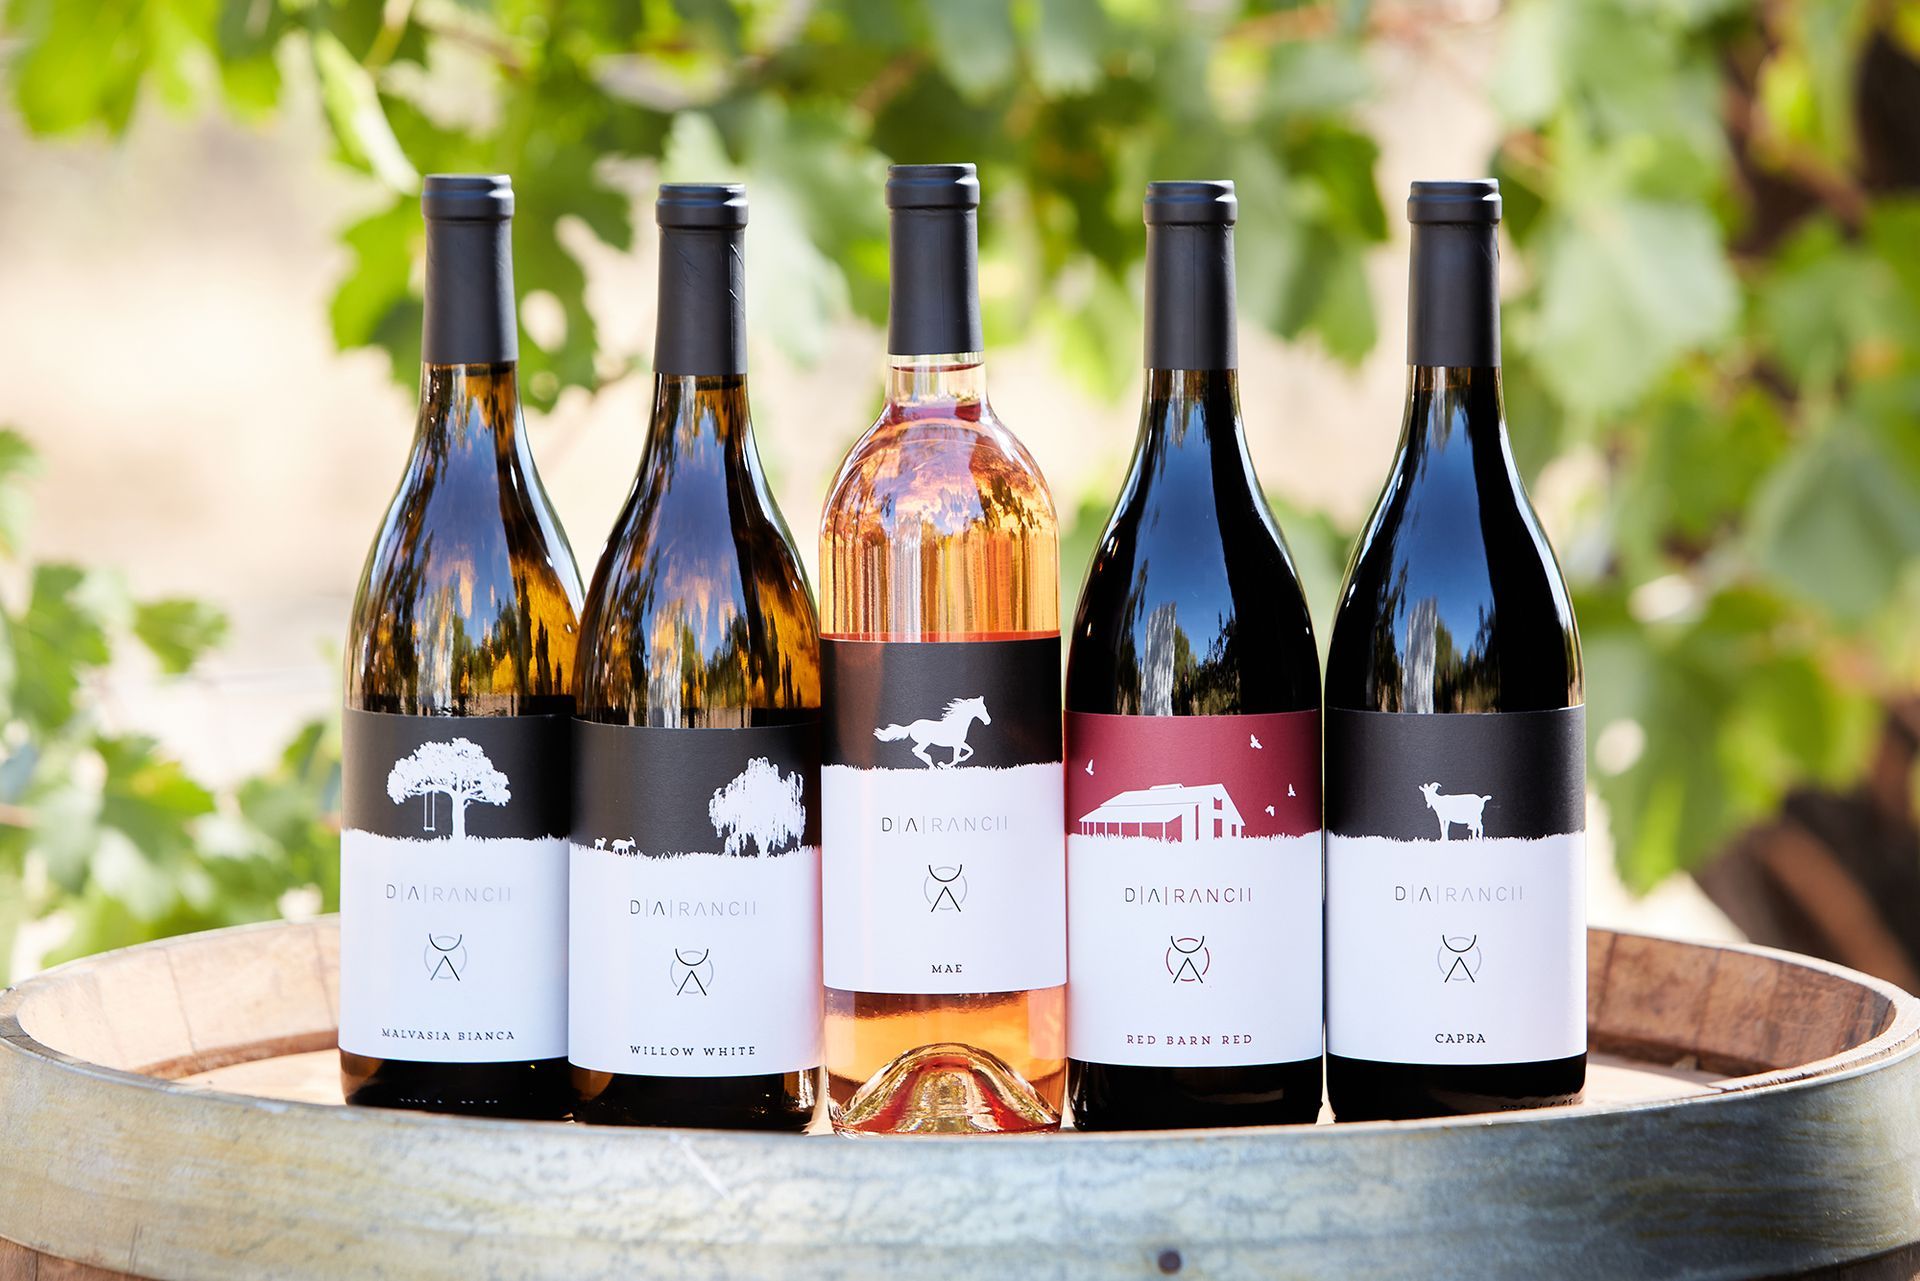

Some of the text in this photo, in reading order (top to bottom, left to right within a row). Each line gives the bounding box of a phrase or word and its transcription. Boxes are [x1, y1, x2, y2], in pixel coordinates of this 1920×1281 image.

[931, 963, 963, 974] MAE
[381, 1028, 515, 1042] MALVASIA BIANCA
[1126, 1034, 1252, 1046] RED BARN RED
[1434, 1032, 1486, 1044] CAPRA
[629, 1044, 756, 1057] WILLOW WHITE
